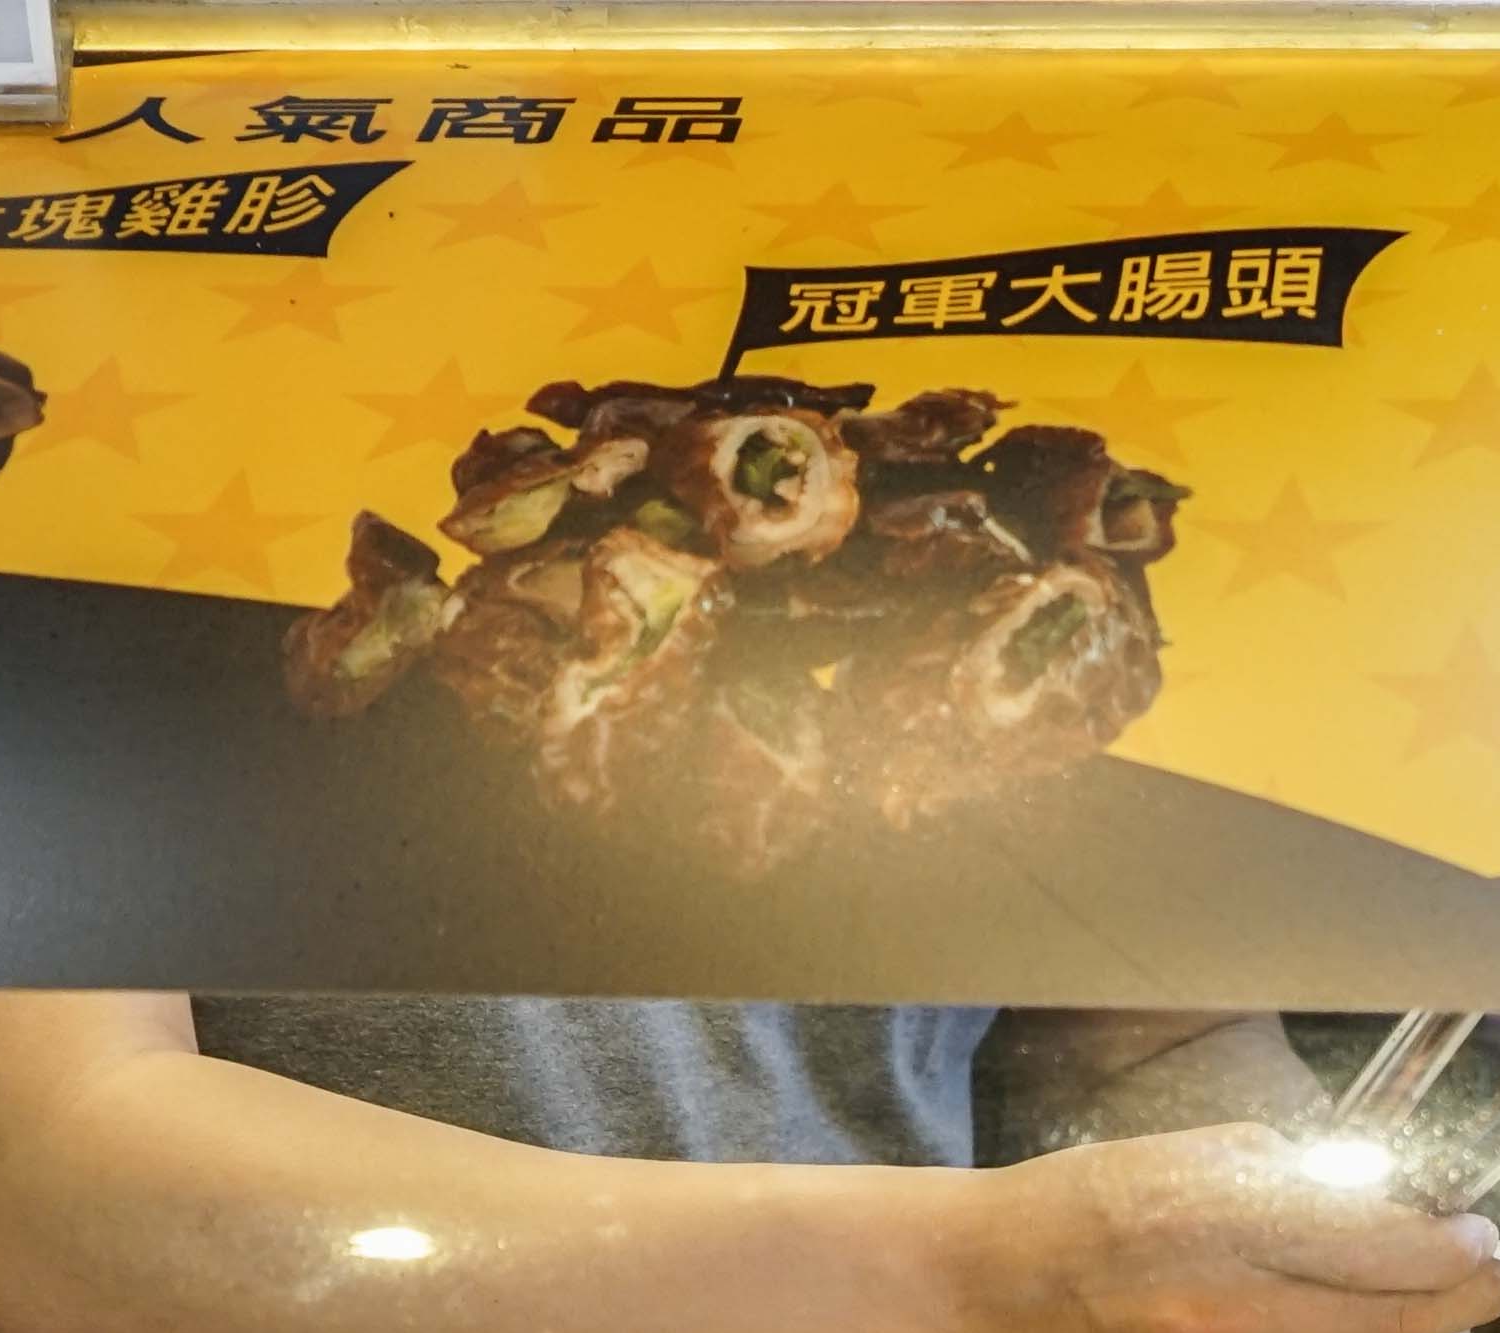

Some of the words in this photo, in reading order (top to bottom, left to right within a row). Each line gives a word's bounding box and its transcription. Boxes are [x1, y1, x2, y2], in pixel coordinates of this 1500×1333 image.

[55, 94, 745, 145] 人氣商品
[779, 246, 1323, 333] 冠軍大腸頭
